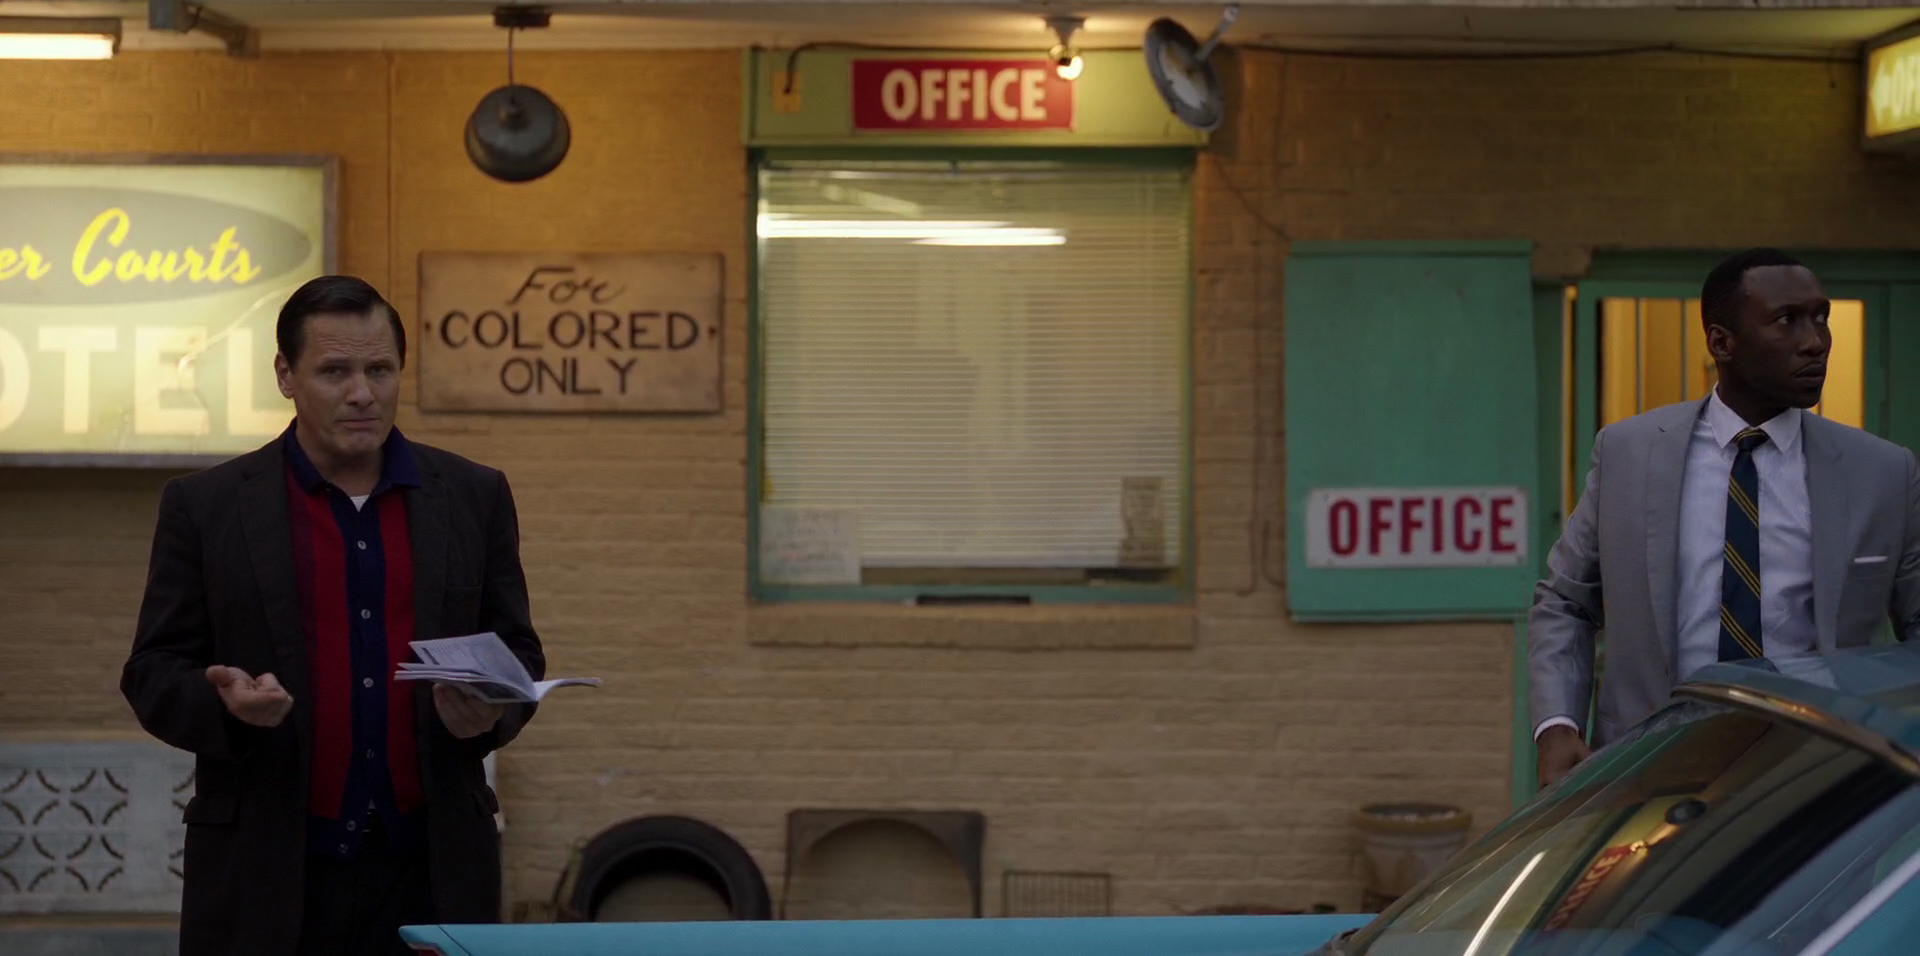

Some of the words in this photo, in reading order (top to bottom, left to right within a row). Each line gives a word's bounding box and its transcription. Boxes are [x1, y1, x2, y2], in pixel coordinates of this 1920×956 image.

[881, 67, 1048, 123] OFFICE
[72, 207, 262, 287] Courts
[505, 264, 627, 306] For
[439, 309, 700, 351] COLORED
[499, 356, 638, 396] ONLY
[1328, 495, 1517, 557] OFFICE
